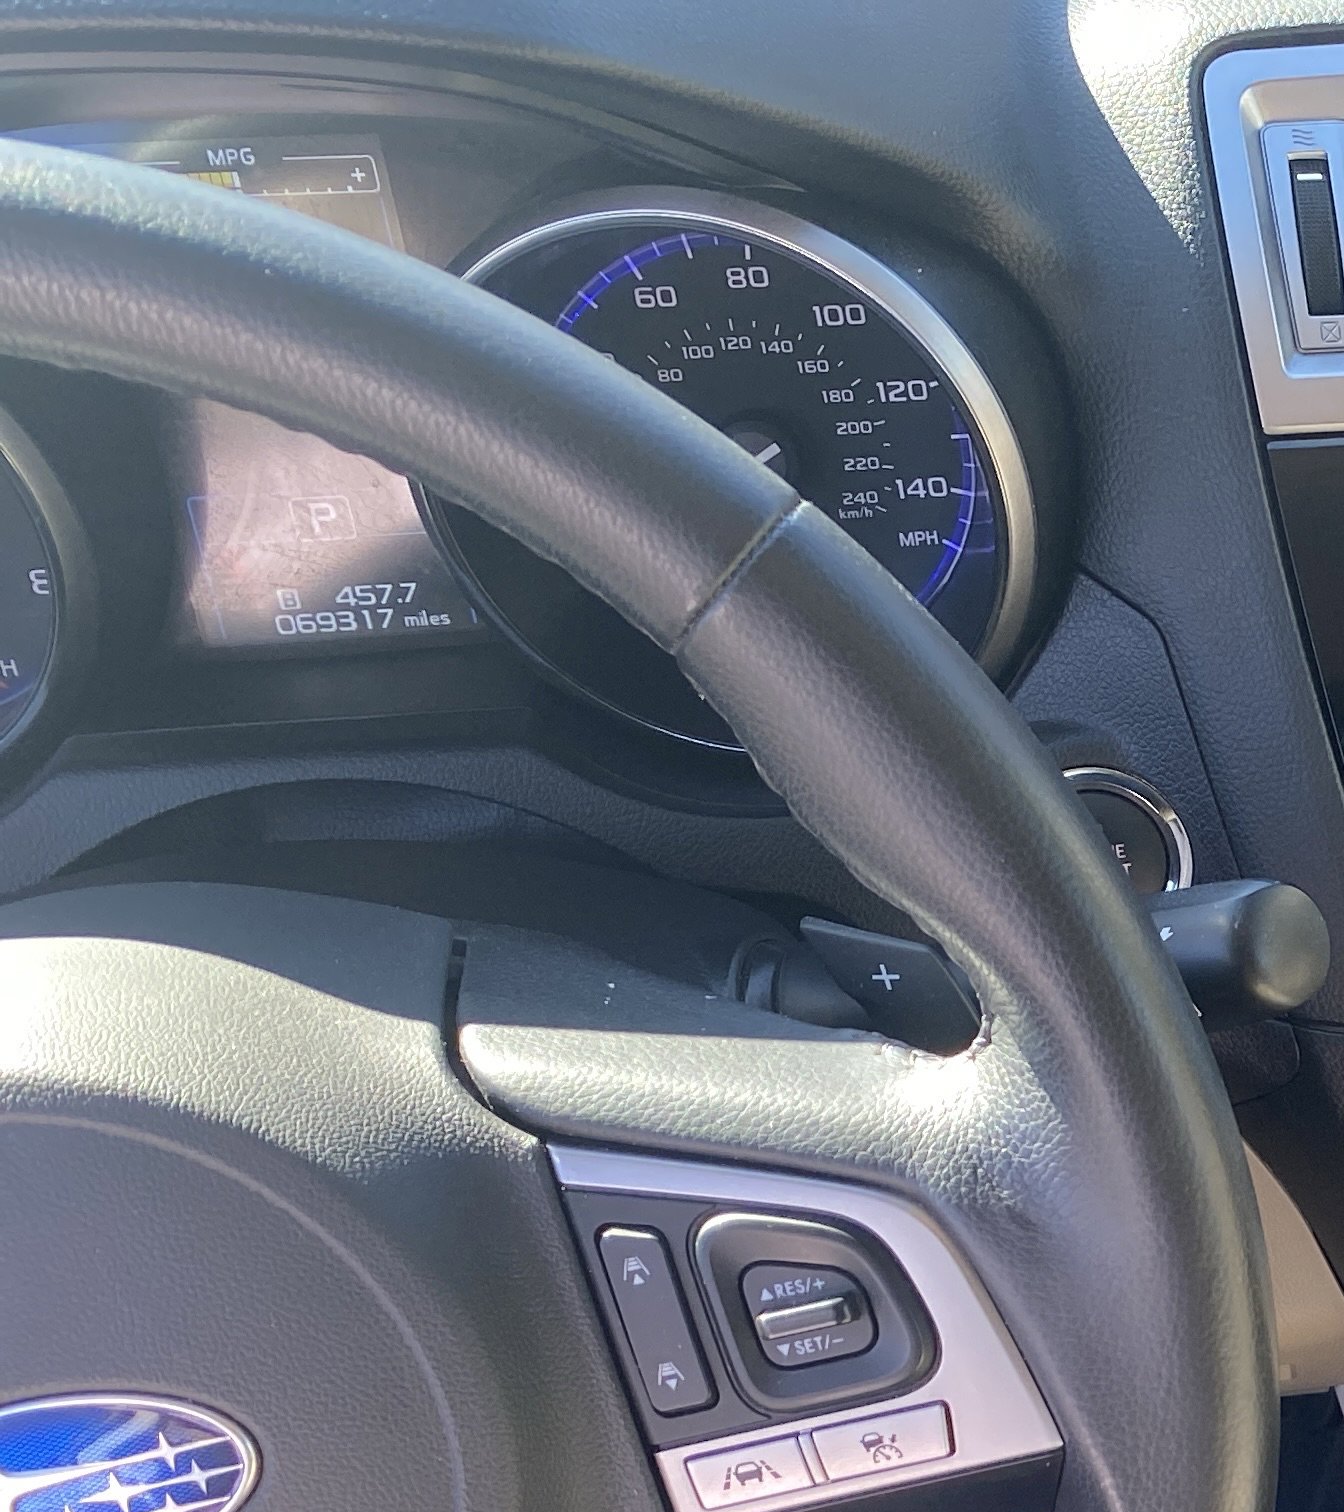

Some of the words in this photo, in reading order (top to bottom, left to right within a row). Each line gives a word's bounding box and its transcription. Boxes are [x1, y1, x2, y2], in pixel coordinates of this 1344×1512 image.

[206, 147, 256, 167] MPG
[726, 266, 769, 289] 80
[634, 286, 678, 308] 60
[813, 303, 866, 327] 100
[719, 336, 752, 350] 120
[760, 340, 794, 354] 140
[682, 345, 714, 360] 100
[657, 368, 683, 383] 80
[797, 359, 830, 374] 160
[821, 389, 854, 404] 180
[876, 379, 929, 402] 120
[835, 421, 873, 435] 200
[843, 456, 880, 471] 220
[842, 490, 879, 505] 240
[894, 477, 948, 500] 140
[307, 502, 336, 536] P
[838, 507, 873, 519] km/h
[898, 530, 939, 548] MPH
[335, 582, 417, 606] 457.7
[275, 608, 394, 636] 069317
[404, 610, 451, 627] miles
[0, 659, 19, 677] H
